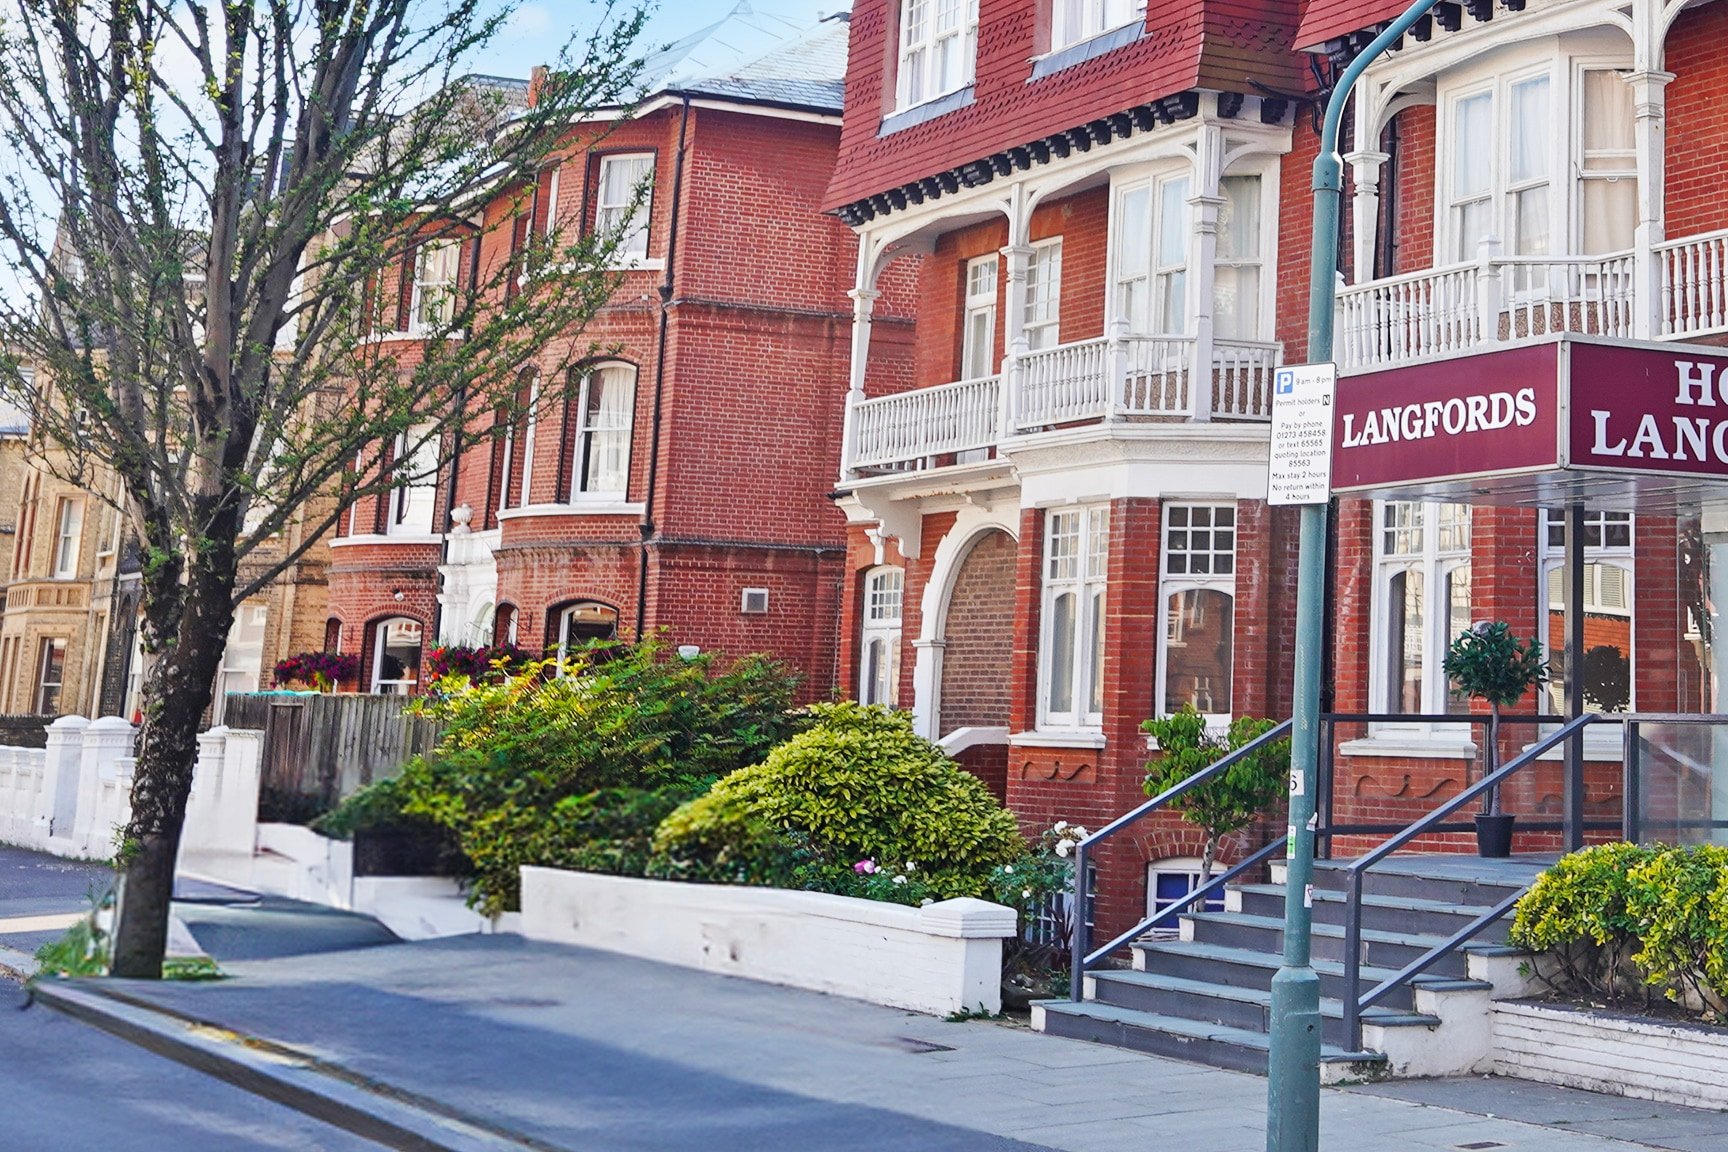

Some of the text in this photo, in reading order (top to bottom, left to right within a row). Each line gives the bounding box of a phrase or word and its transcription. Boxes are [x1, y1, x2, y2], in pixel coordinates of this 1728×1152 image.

[1280, 373, 1292, 393] P
[1276, 399, 1296, 407] Permit
[1341, 387, 1537, 448] LANGFORDS
[1281, 422, 1291, 430] Pay
[1276, 429, 1326, 439] 01273 458458
[1301, 439, 1323, 448] 65565
